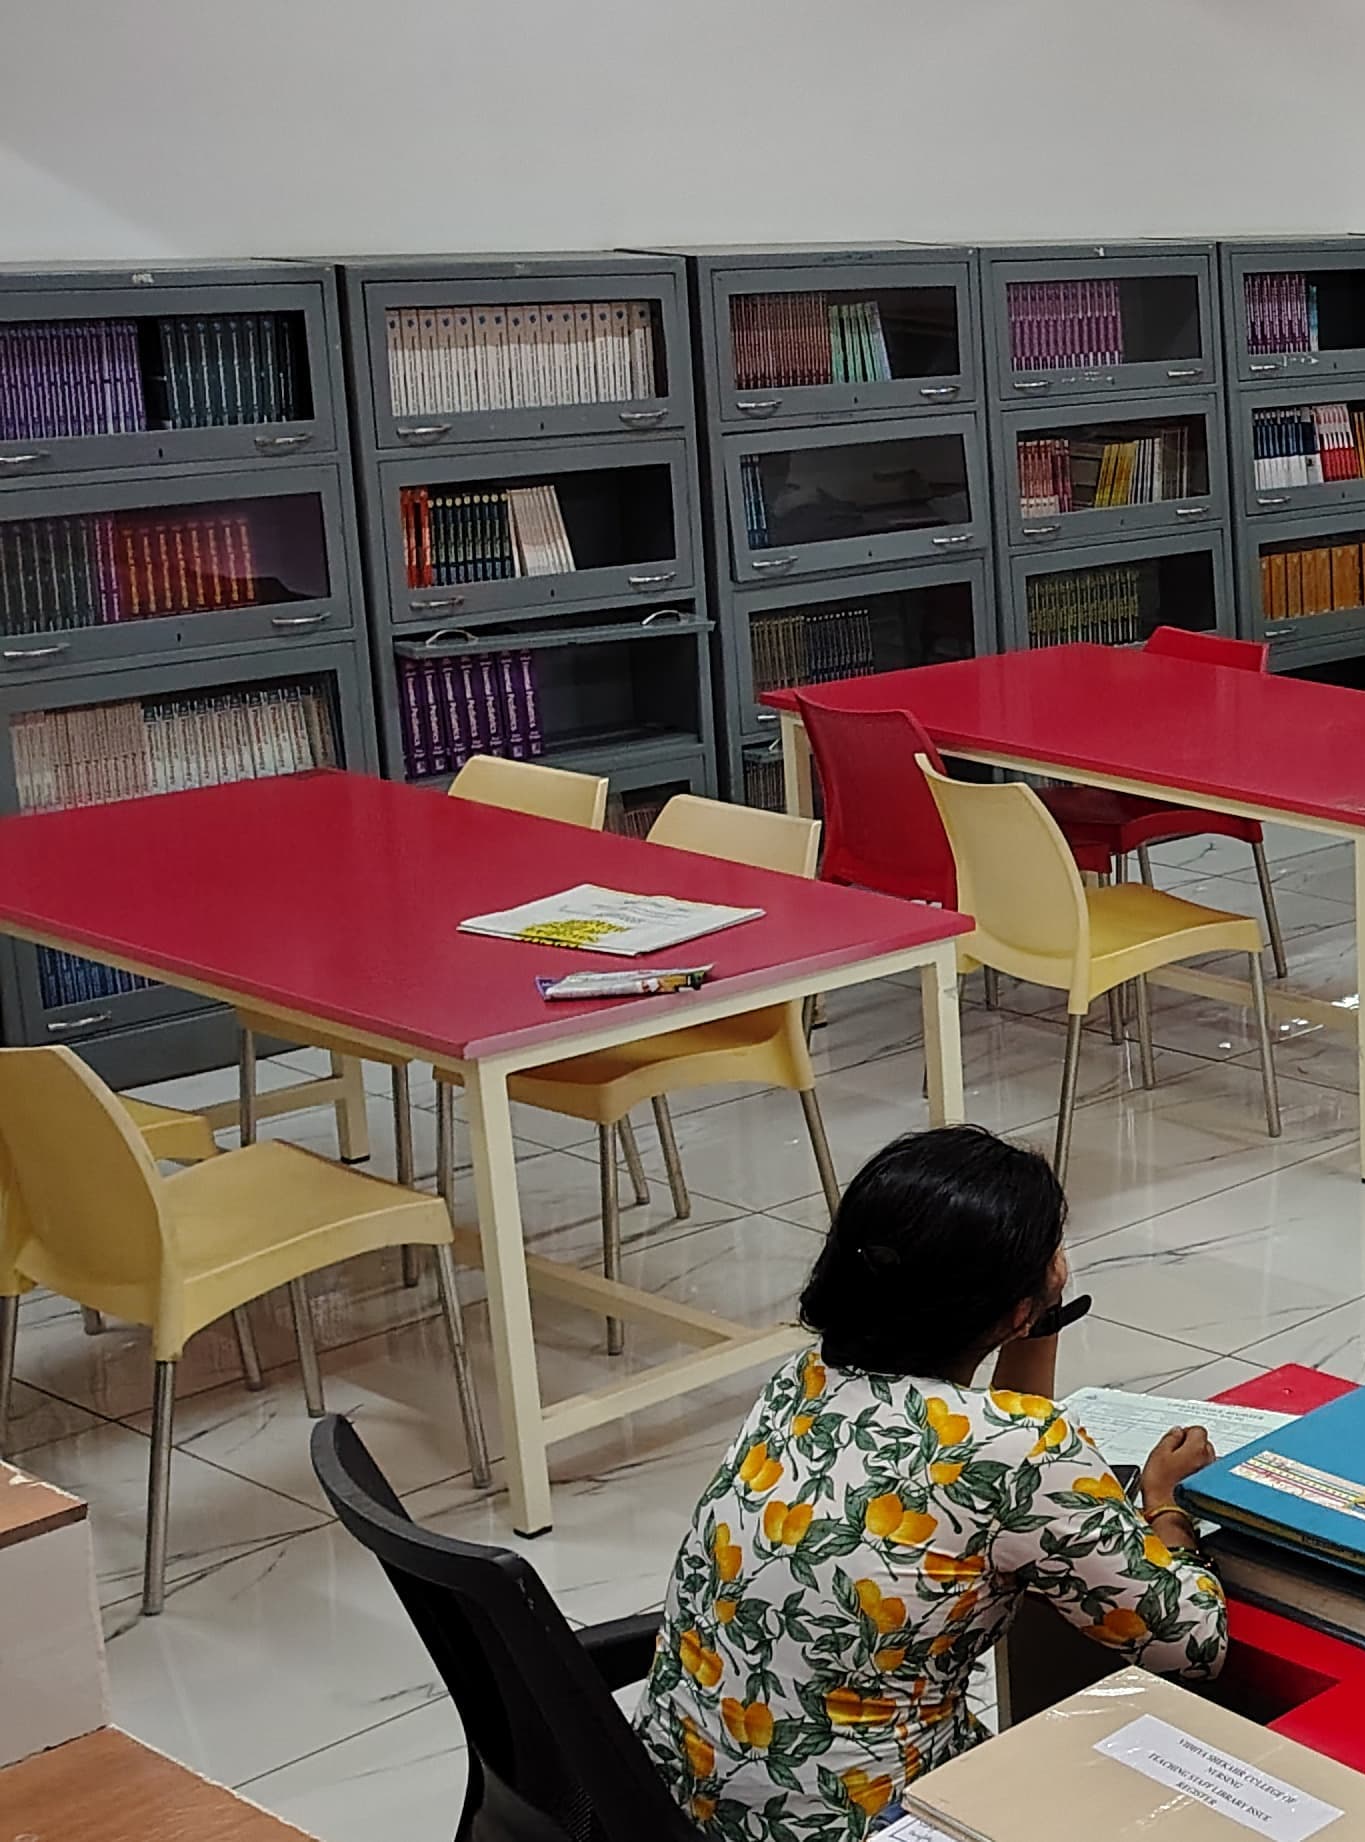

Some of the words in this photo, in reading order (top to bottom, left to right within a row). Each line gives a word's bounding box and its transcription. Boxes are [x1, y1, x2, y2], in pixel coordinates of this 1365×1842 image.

[1148, 1752, 1191, 1778] TEACHING
[1188, 1775, 1214, 1788] STAFF
[1211, 1786, 1248, 1809] LIBRARY
[1246, 1806, 1272, 1821] ISSUE
[1208, 1766, 1244, 1789] NURSING
[1244, 1774, 1285, 1798] COLLEGE
[1282, 1795, 1297, 1804] OF
[1176, 1782, 1217, 1805] REGISTER
